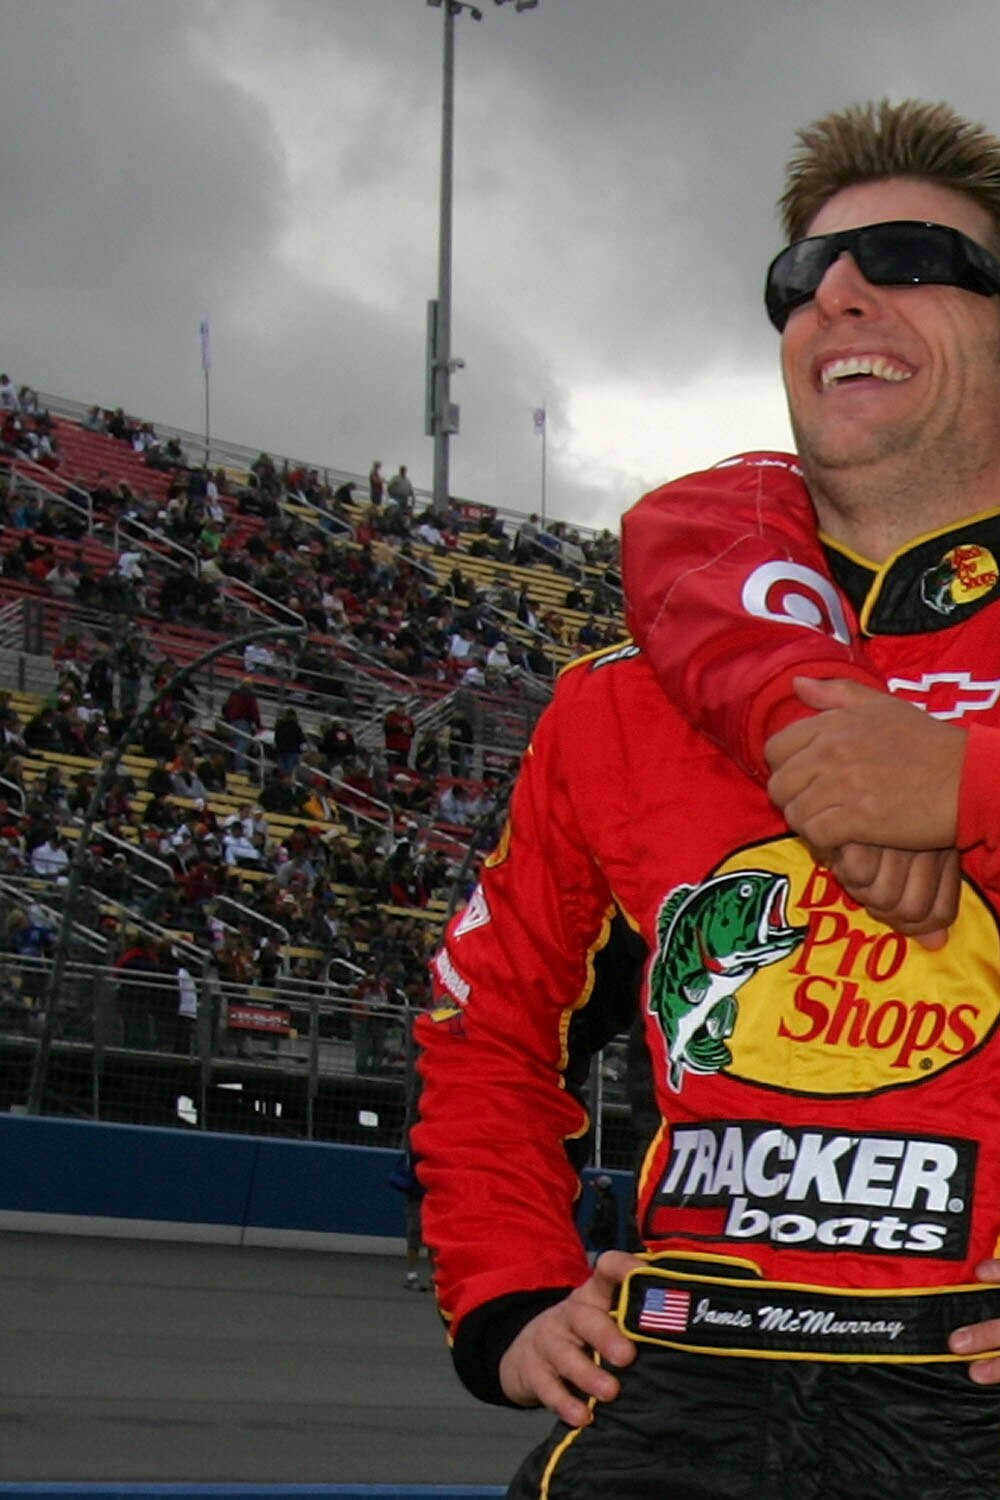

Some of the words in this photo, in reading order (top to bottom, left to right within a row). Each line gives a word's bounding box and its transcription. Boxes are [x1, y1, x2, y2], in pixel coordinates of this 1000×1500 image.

[788, 910, 908, 983] Pro
[777, 975, 982, 1069] Shops
[662, 1126, 959, 1213] TRACKER
[724, 1197, 949, 1252] boats
[692, 1298, 753, 1328] Jamie
[757, 1304, 905, 1341] McMurray
